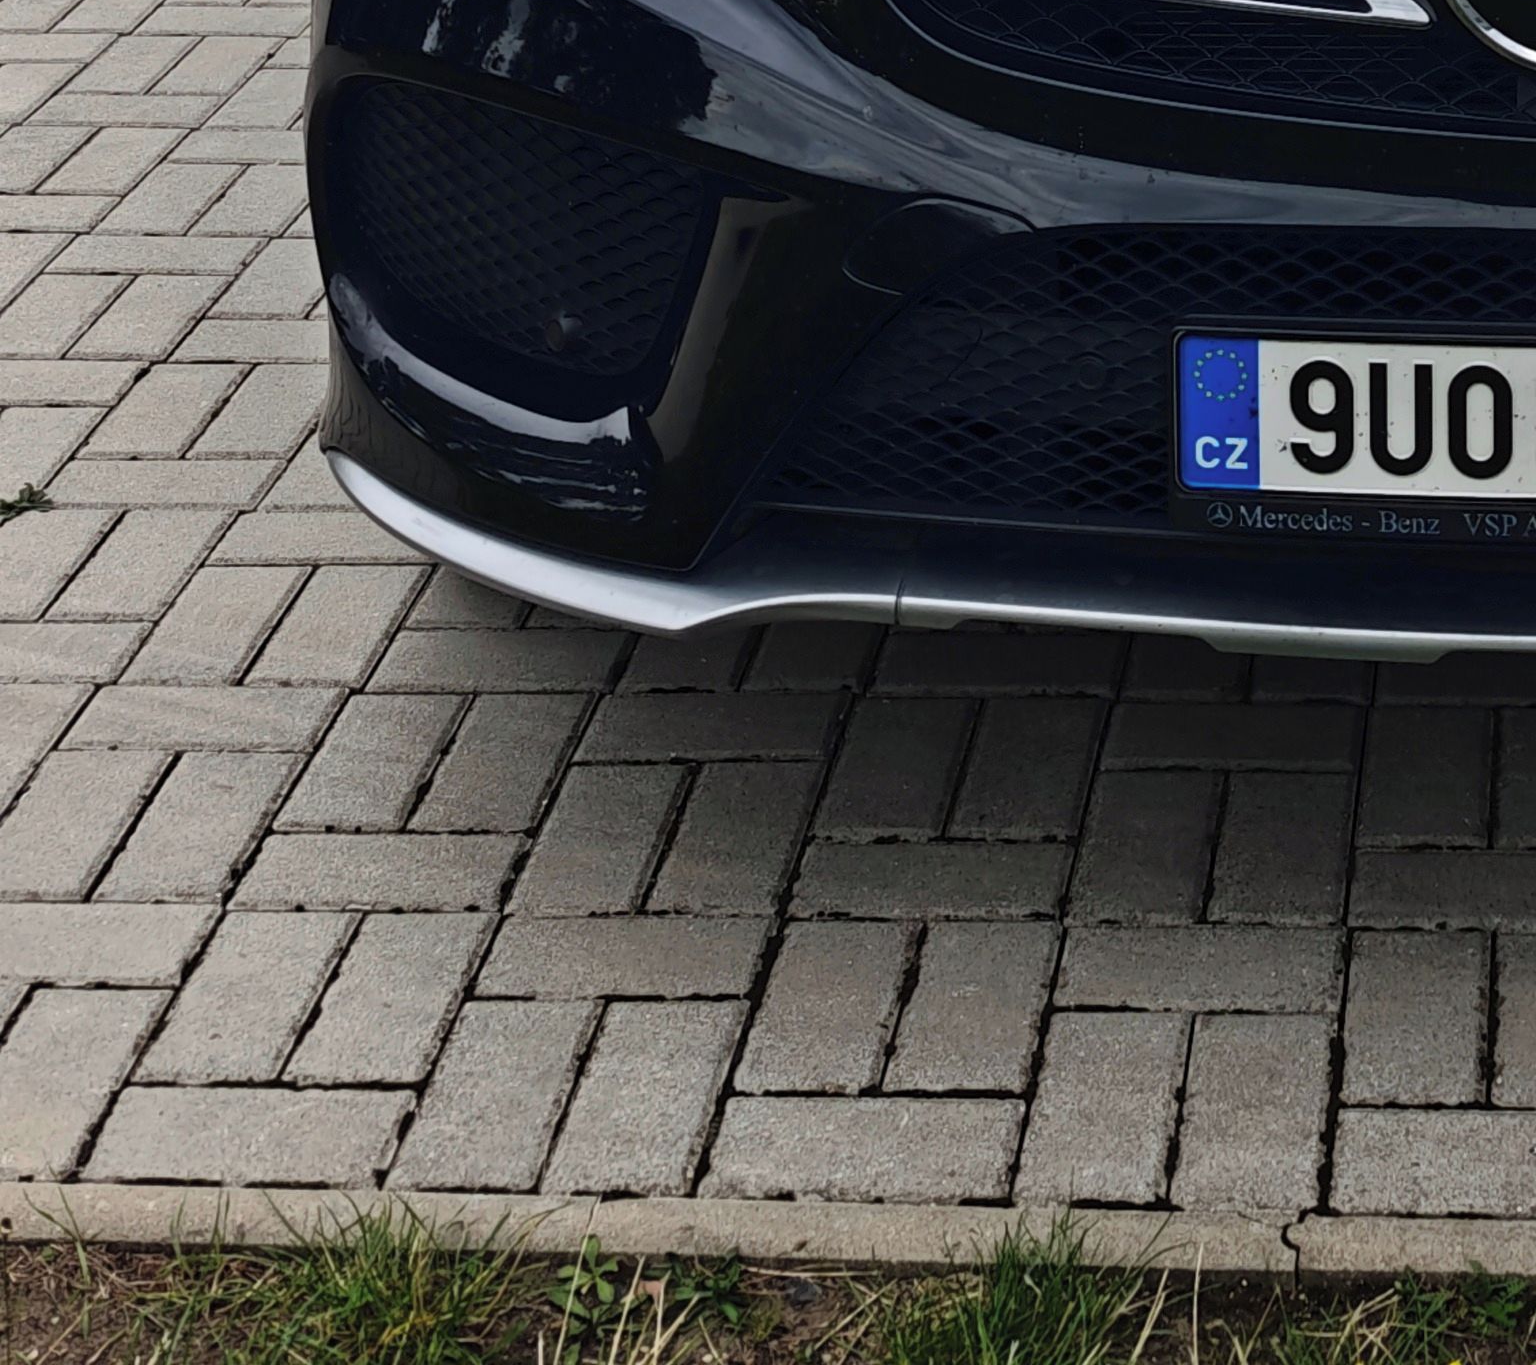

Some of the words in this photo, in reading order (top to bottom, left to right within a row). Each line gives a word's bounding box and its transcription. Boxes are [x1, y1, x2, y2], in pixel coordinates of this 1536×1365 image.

[1195, 435, 1249, 470] CZ
[1239, 505, 1353, 532] Mercedes
[1378, 510, 1441, 535] Benz
[1463, 513, 1518, 537] VSP
